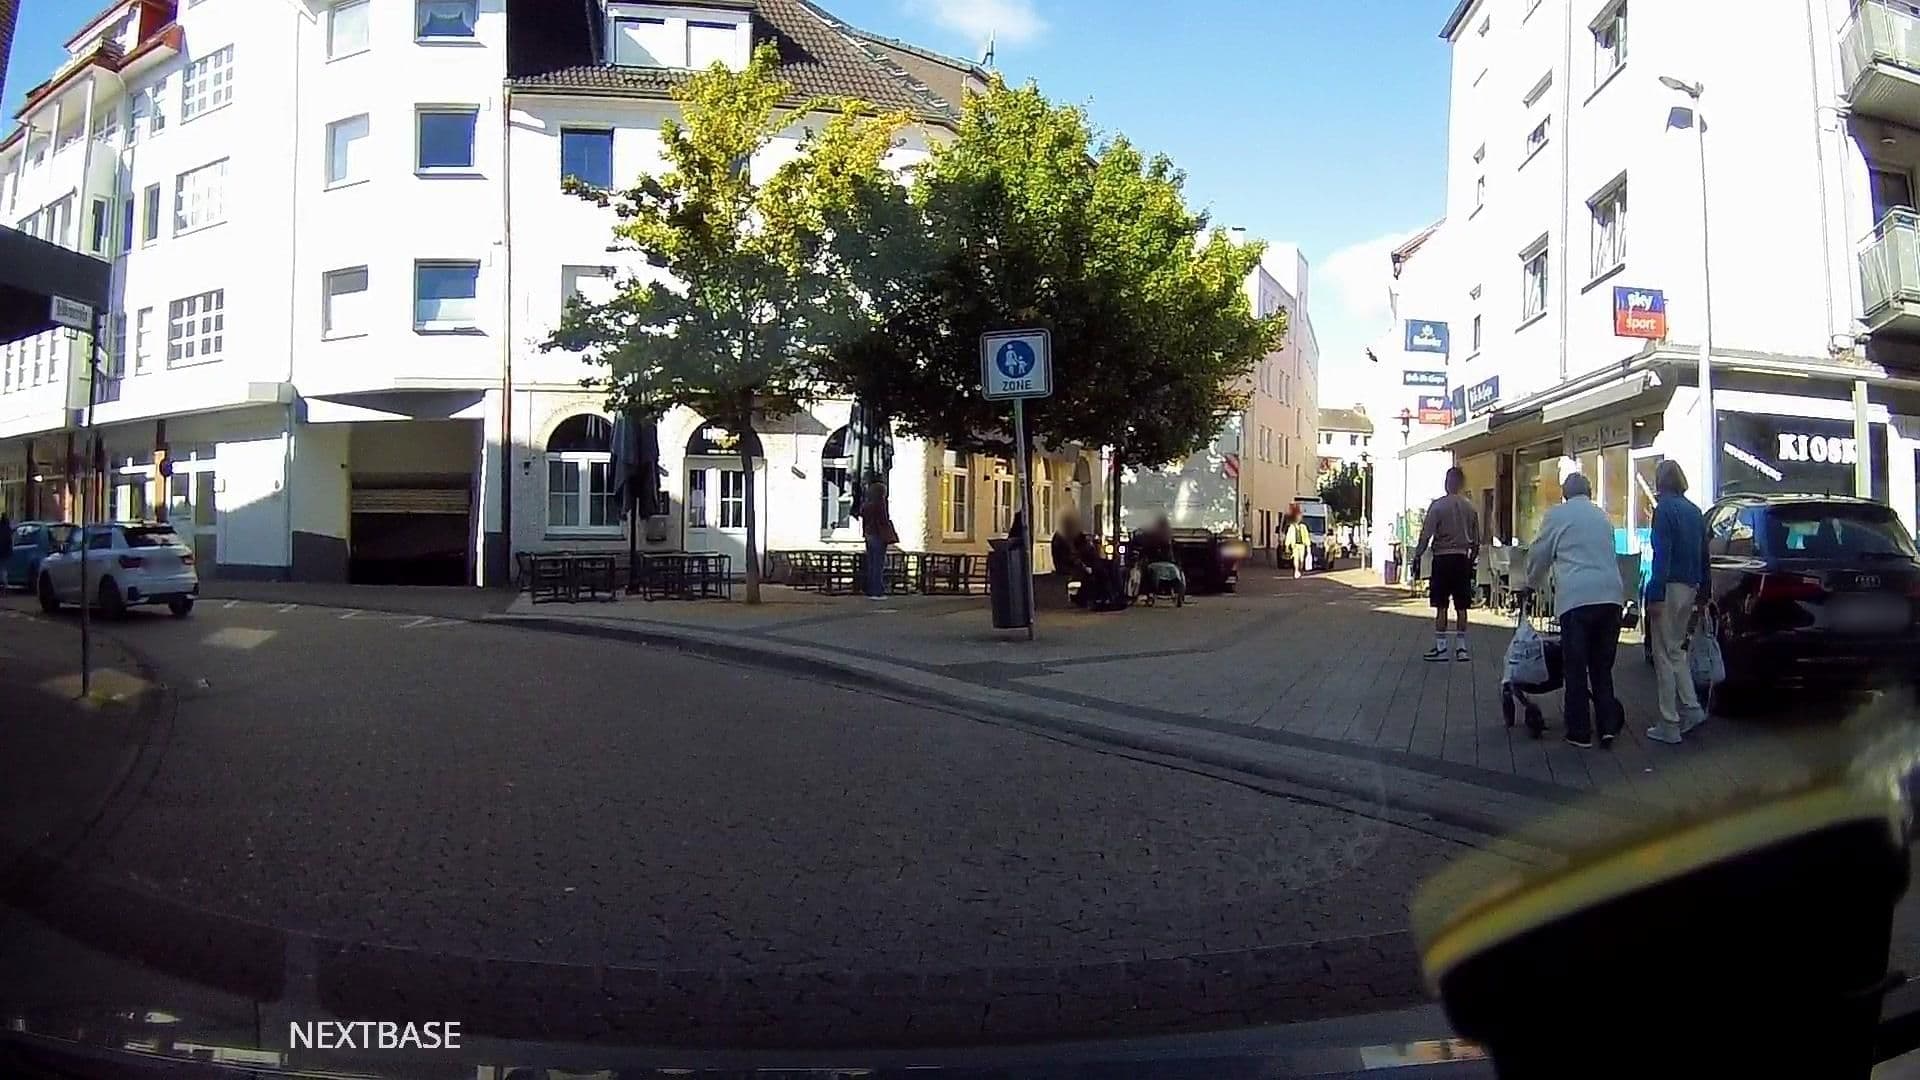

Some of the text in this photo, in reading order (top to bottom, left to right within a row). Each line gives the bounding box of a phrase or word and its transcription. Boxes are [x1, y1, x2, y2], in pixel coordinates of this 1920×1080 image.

[1626, 318, 1657, 332] sport
[1002, 380, 1032, 392] ZONE
[1778, 433, 1857, 464] KIOSK
